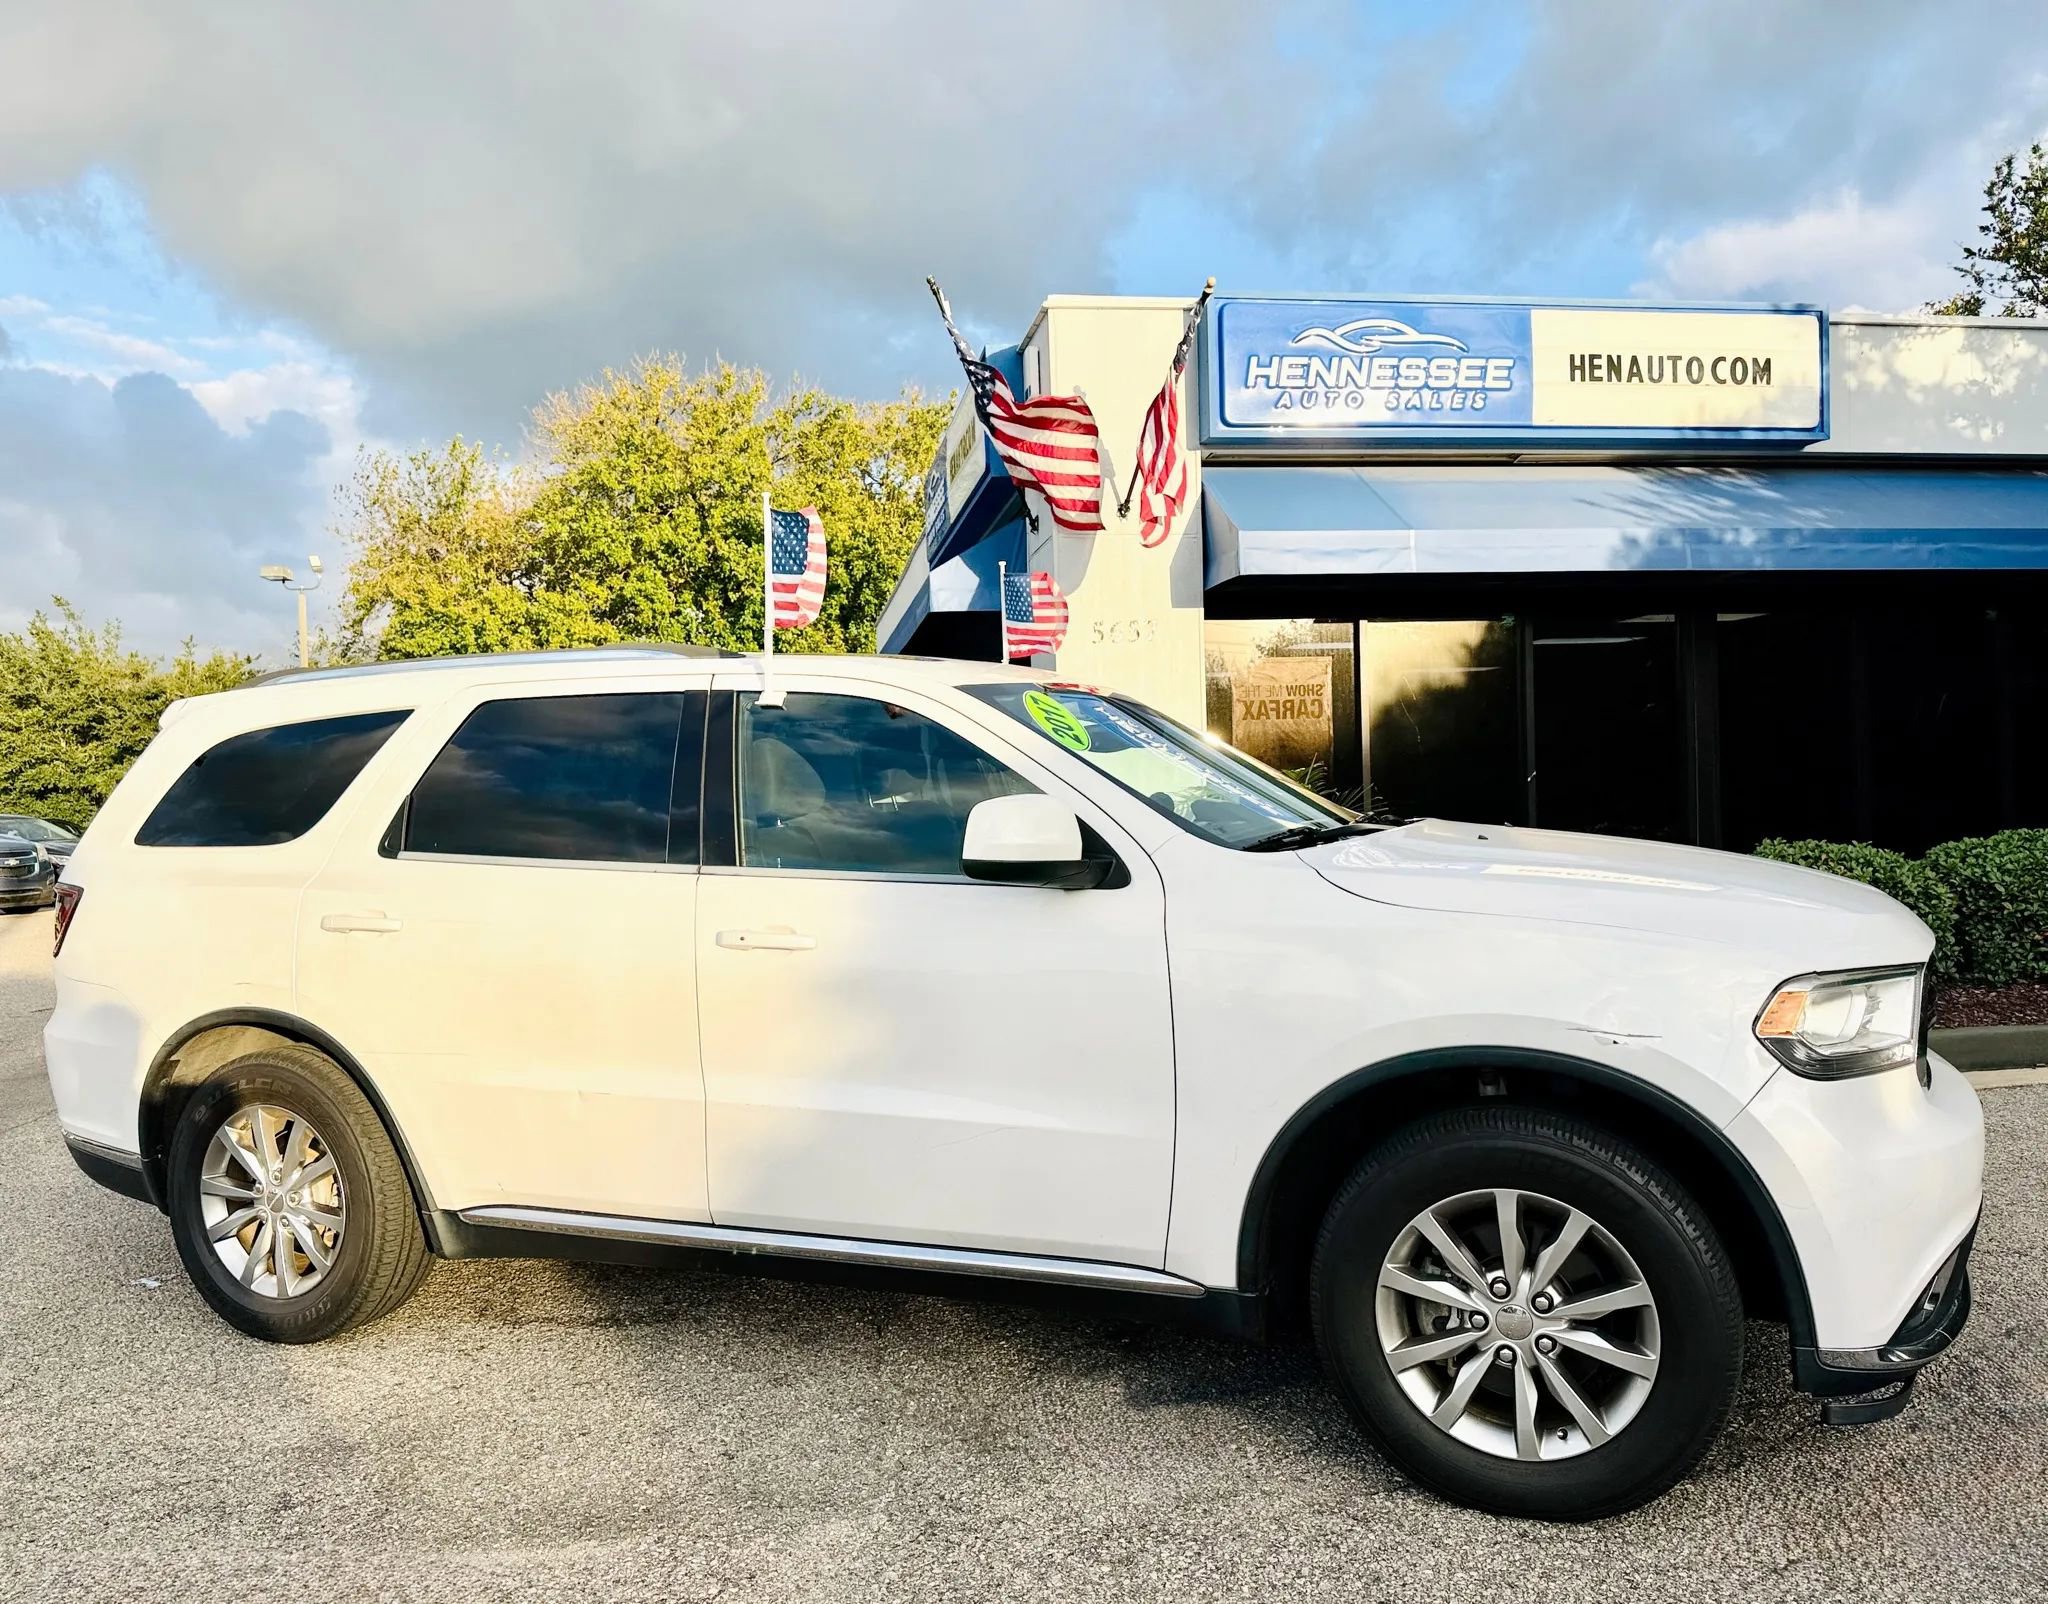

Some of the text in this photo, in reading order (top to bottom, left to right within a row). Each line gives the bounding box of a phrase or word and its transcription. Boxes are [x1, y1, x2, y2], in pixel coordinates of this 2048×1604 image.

[1246, 355, 1515, 390] HENNESSEE
[1275, 391, 1487, 411] AUTO SALES
[1029, 694, 1085, 746] 2017
